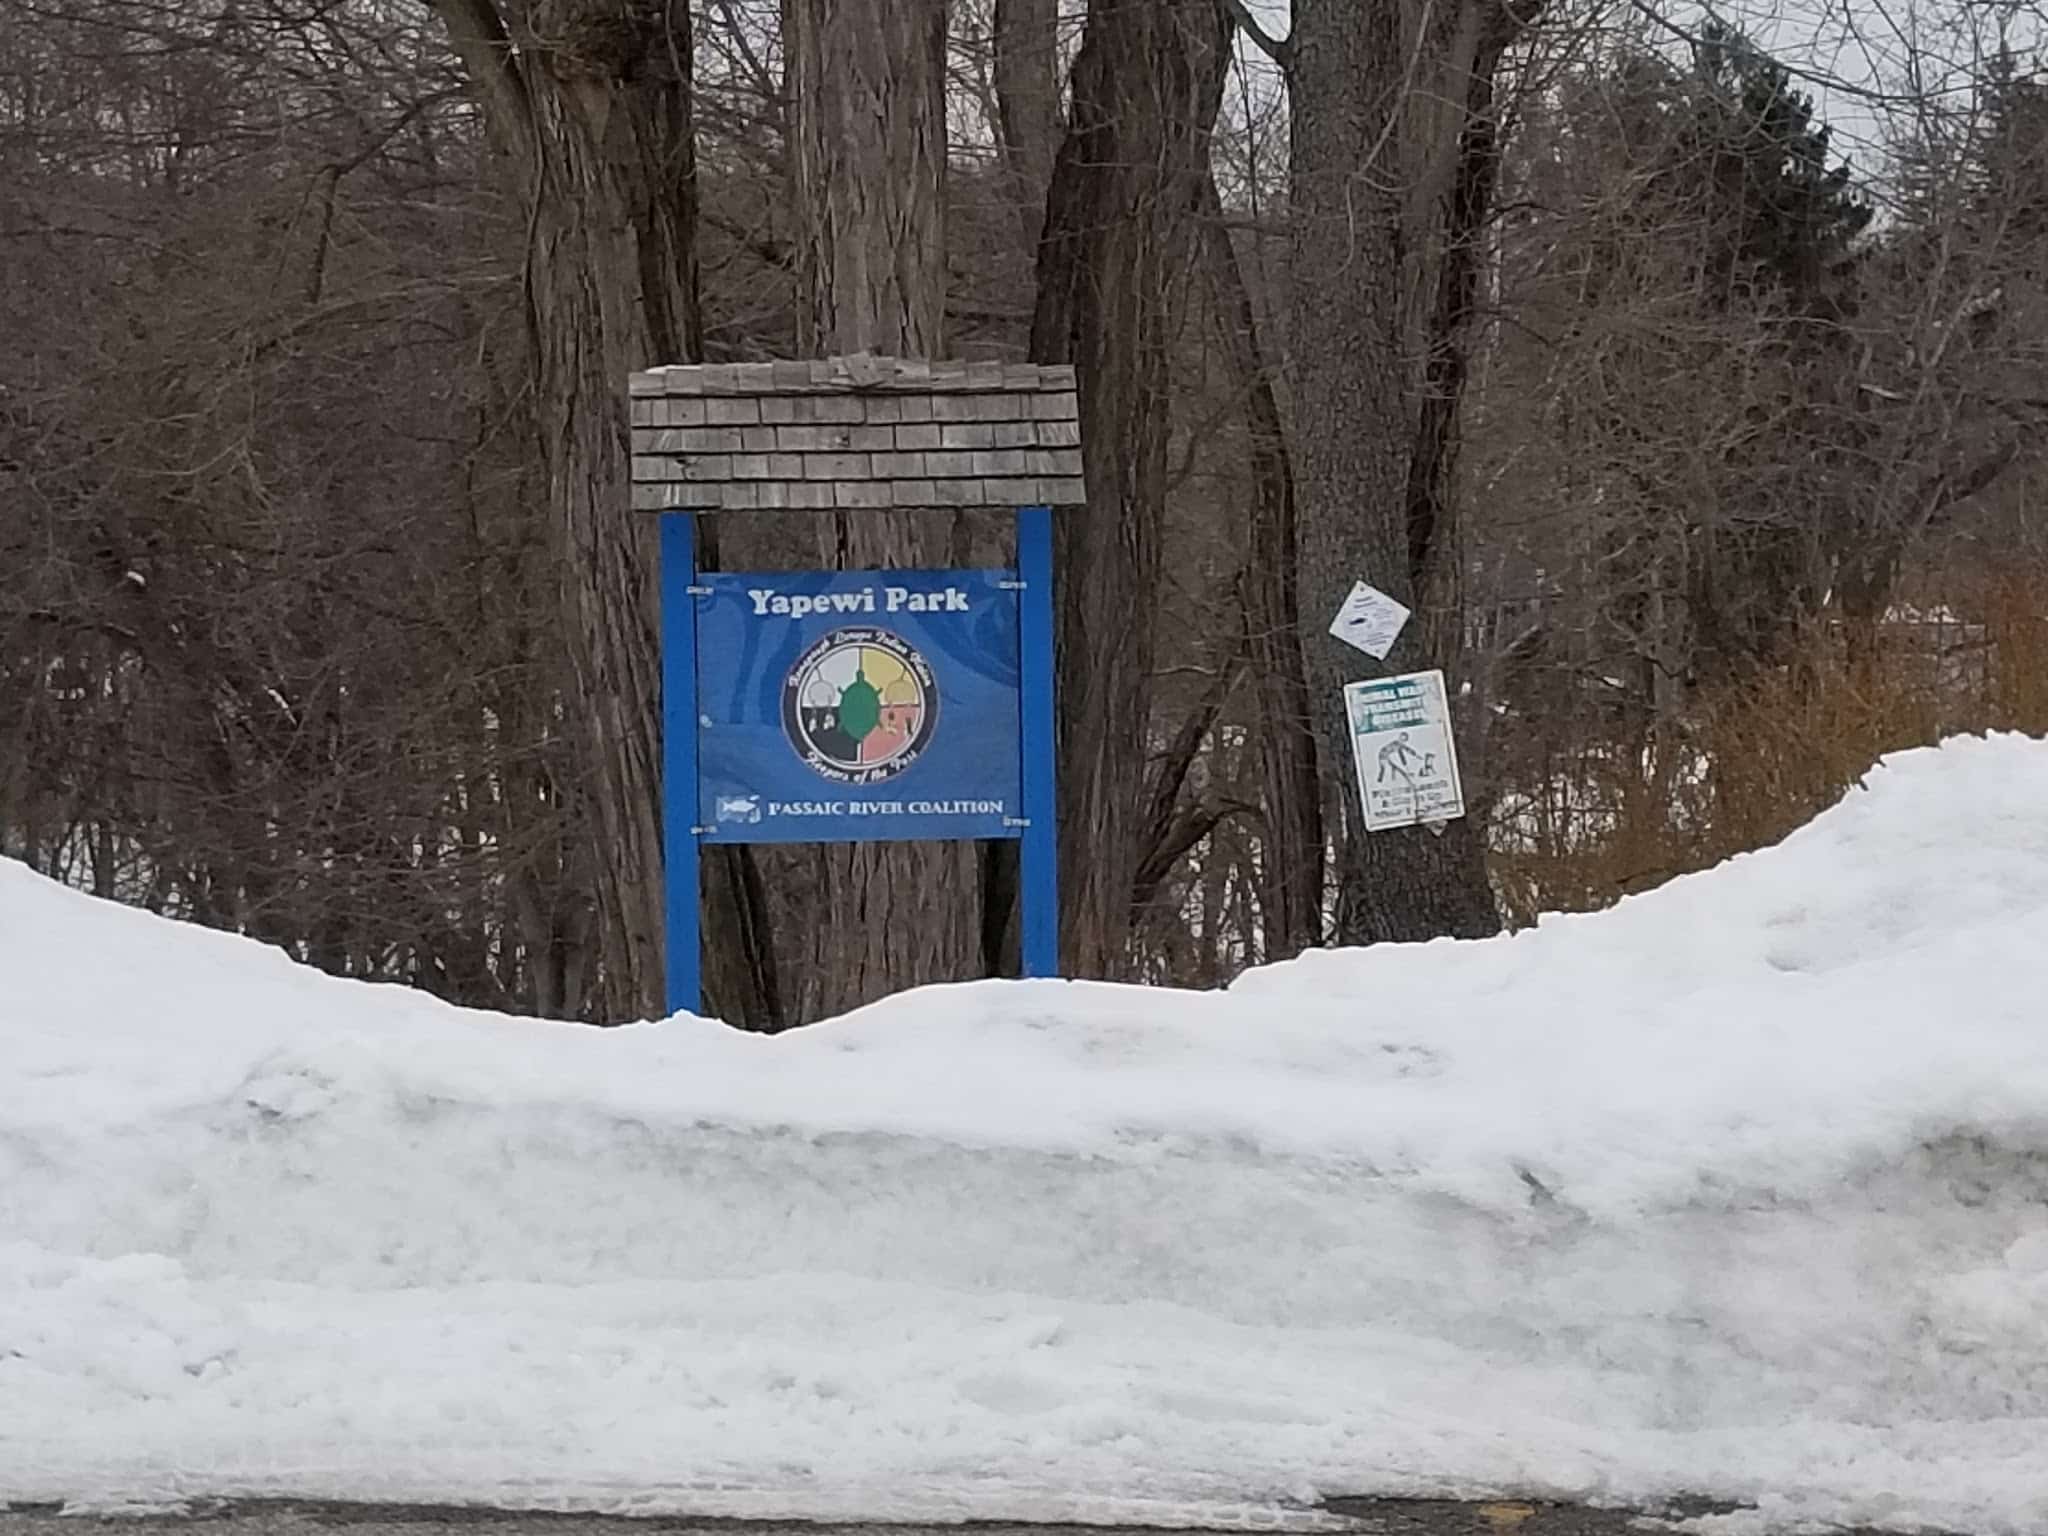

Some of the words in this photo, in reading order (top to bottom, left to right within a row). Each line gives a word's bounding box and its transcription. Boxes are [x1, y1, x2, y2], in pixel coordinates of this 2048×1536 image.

[748, 587, 874, 618] Yapewi
[885, 588, 969, 611] Park
[768, 802, 843, 816] PASSAIC
[849, 801, 902, 815] RIVER
[908, 800, 1003, 815] COALITION
